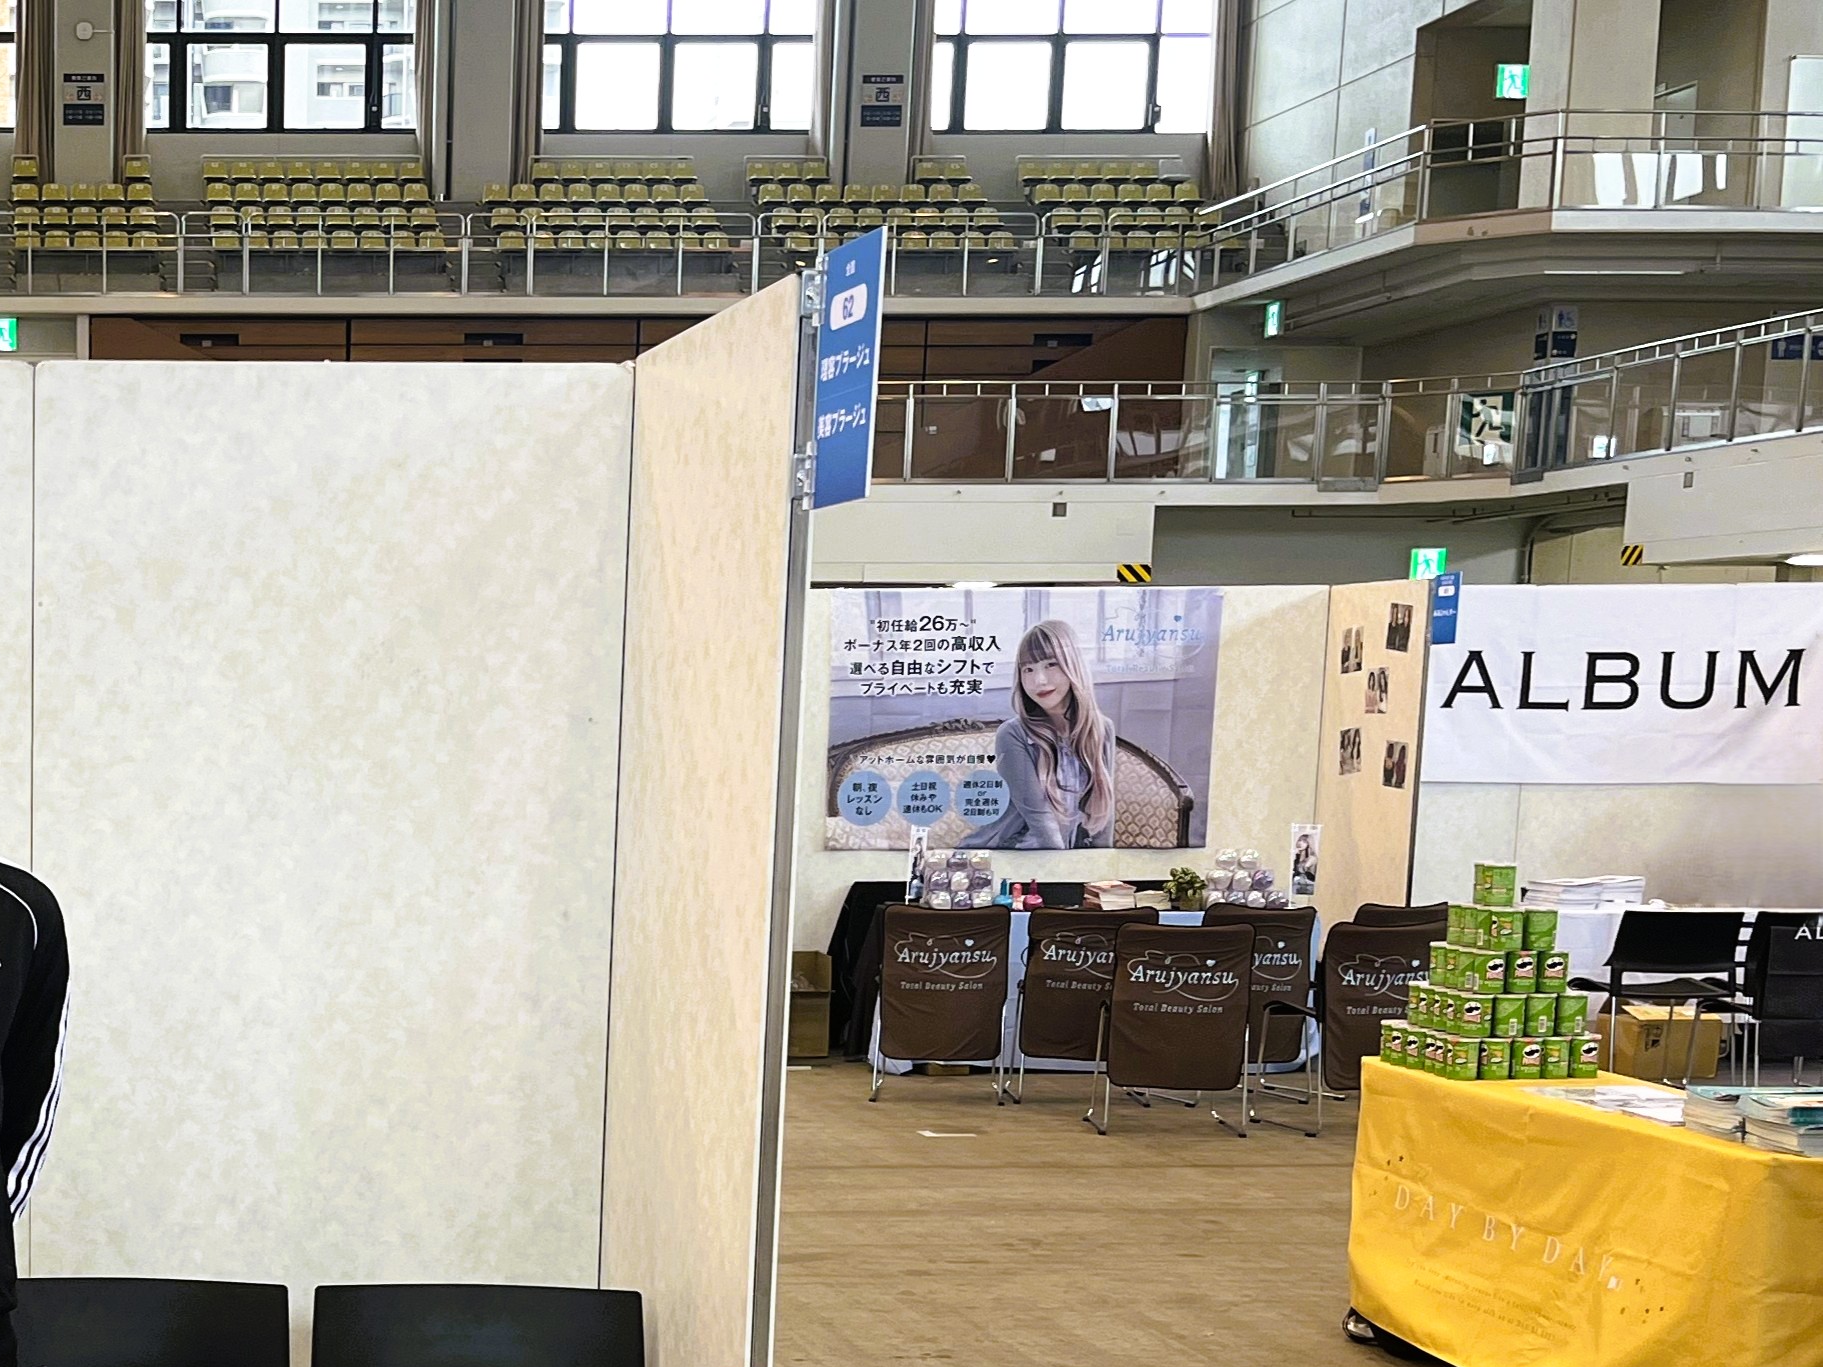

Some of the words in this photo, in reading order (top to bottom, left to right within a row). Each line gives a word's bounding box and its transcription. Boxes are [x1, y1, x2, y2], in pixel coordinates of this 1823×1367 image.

[842, 294, 855, 320] 62
[844, 636, 1001, 652] ボーナス年2回の高収入
[849, 659, 994, 676] 選べる自由なシフトで
[860, 679, 983, 695] プライベートも充実
[1439, 648, 1806, 712] ALBUM
[897, 947, 993, 968] Arujyansu
[1130, 964, 1235, 991] Arujyansu
[1133, 1002, 1158, 1012] Total
[1394, 1184, 1464, 1230] DAY
[1482, 1215, 1525, 1251] BY
[1542, 1236, 1614, 1281] DAY
